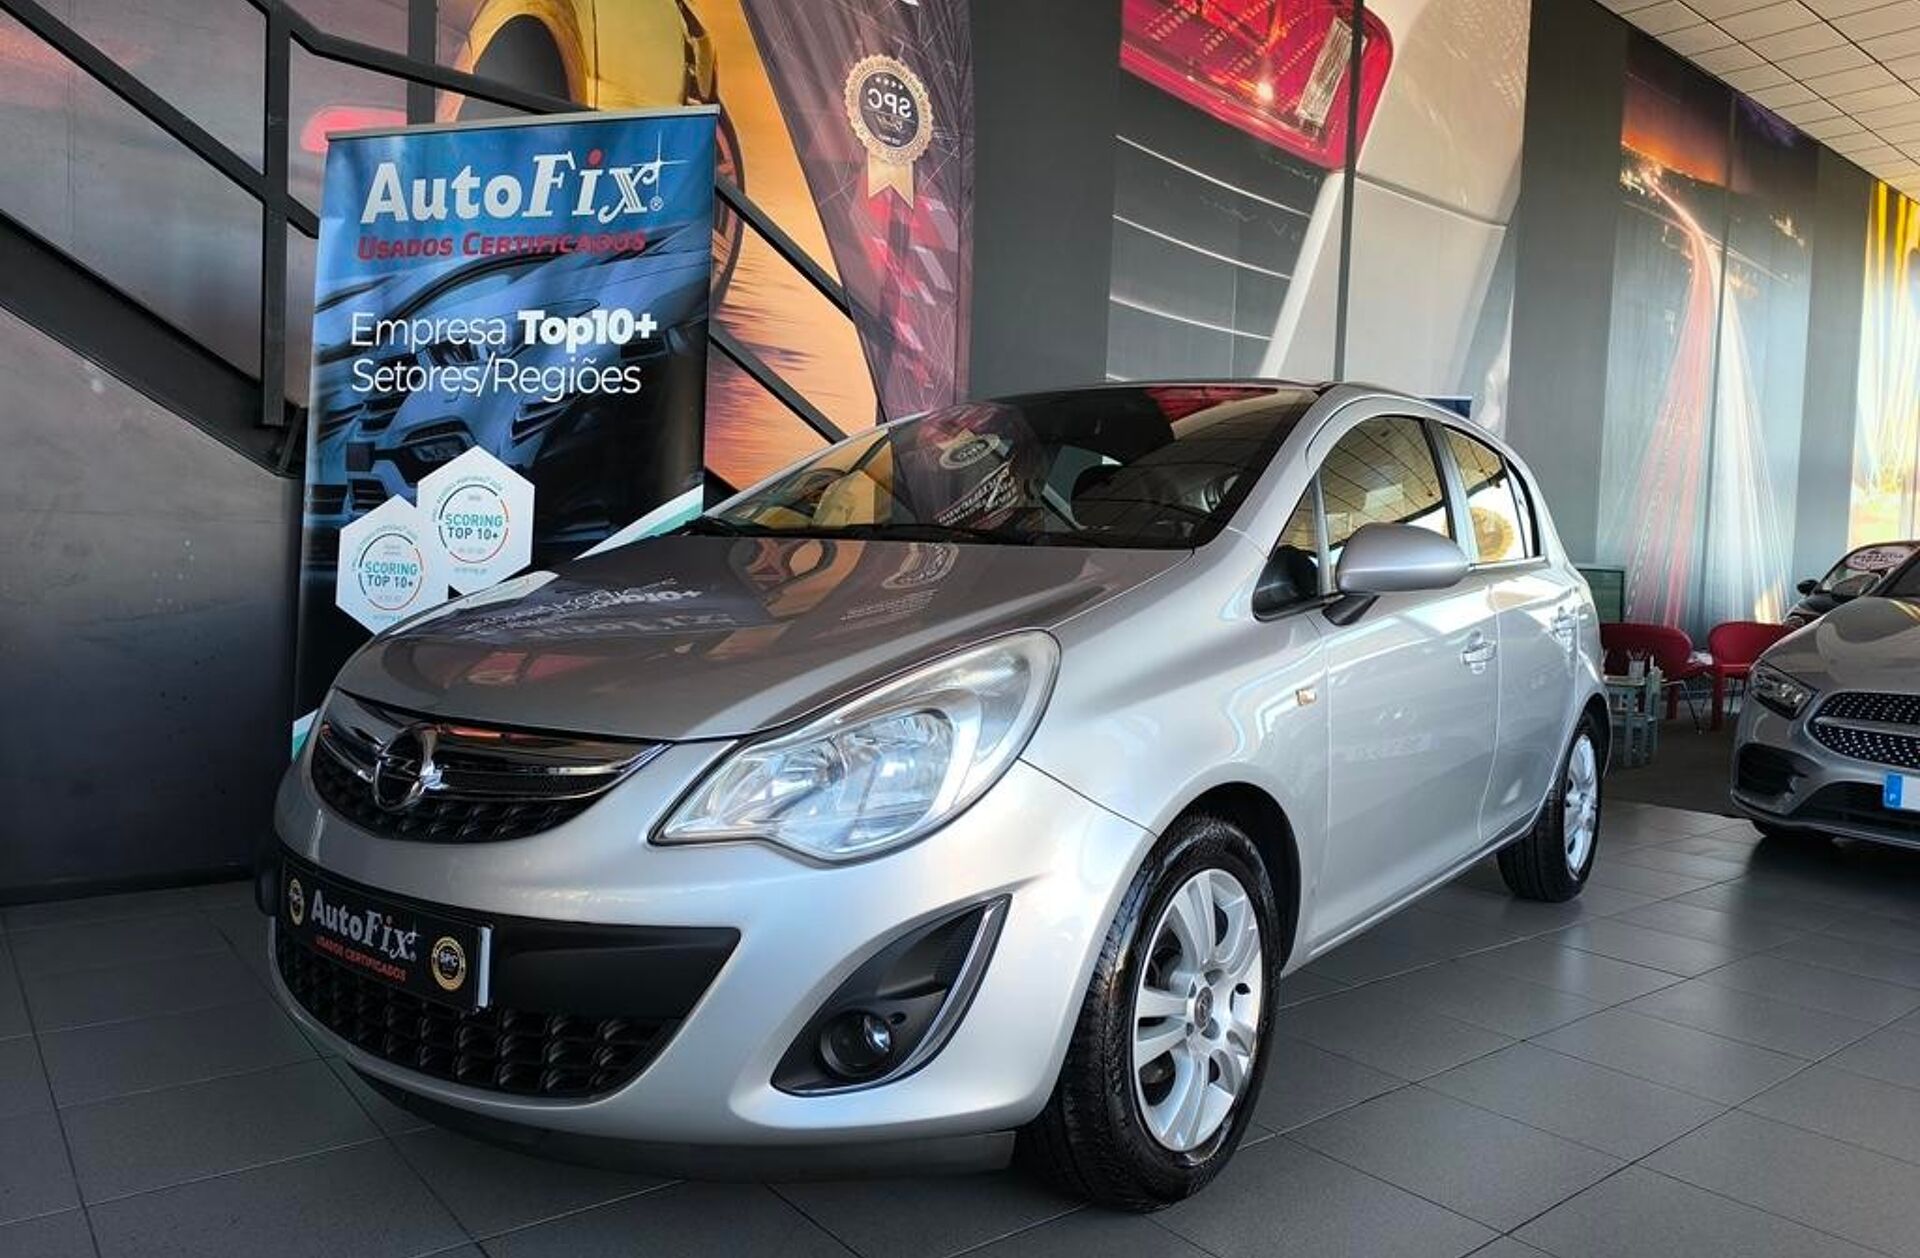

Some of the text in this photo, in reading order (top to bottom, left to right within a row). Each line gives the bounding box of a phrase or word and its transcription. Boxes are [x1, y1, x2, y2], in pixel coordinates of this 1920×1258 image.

[351, 308, 657, 353] Empresa Top10+
[351, 355, 642, 402] Setores/Regiões
[445, 514, 503, 528] SCORING
[448, 527, 473, 539] TOP
[365, 561, 418, 576] SCORING
[367, 574, 390, 588] TOP
